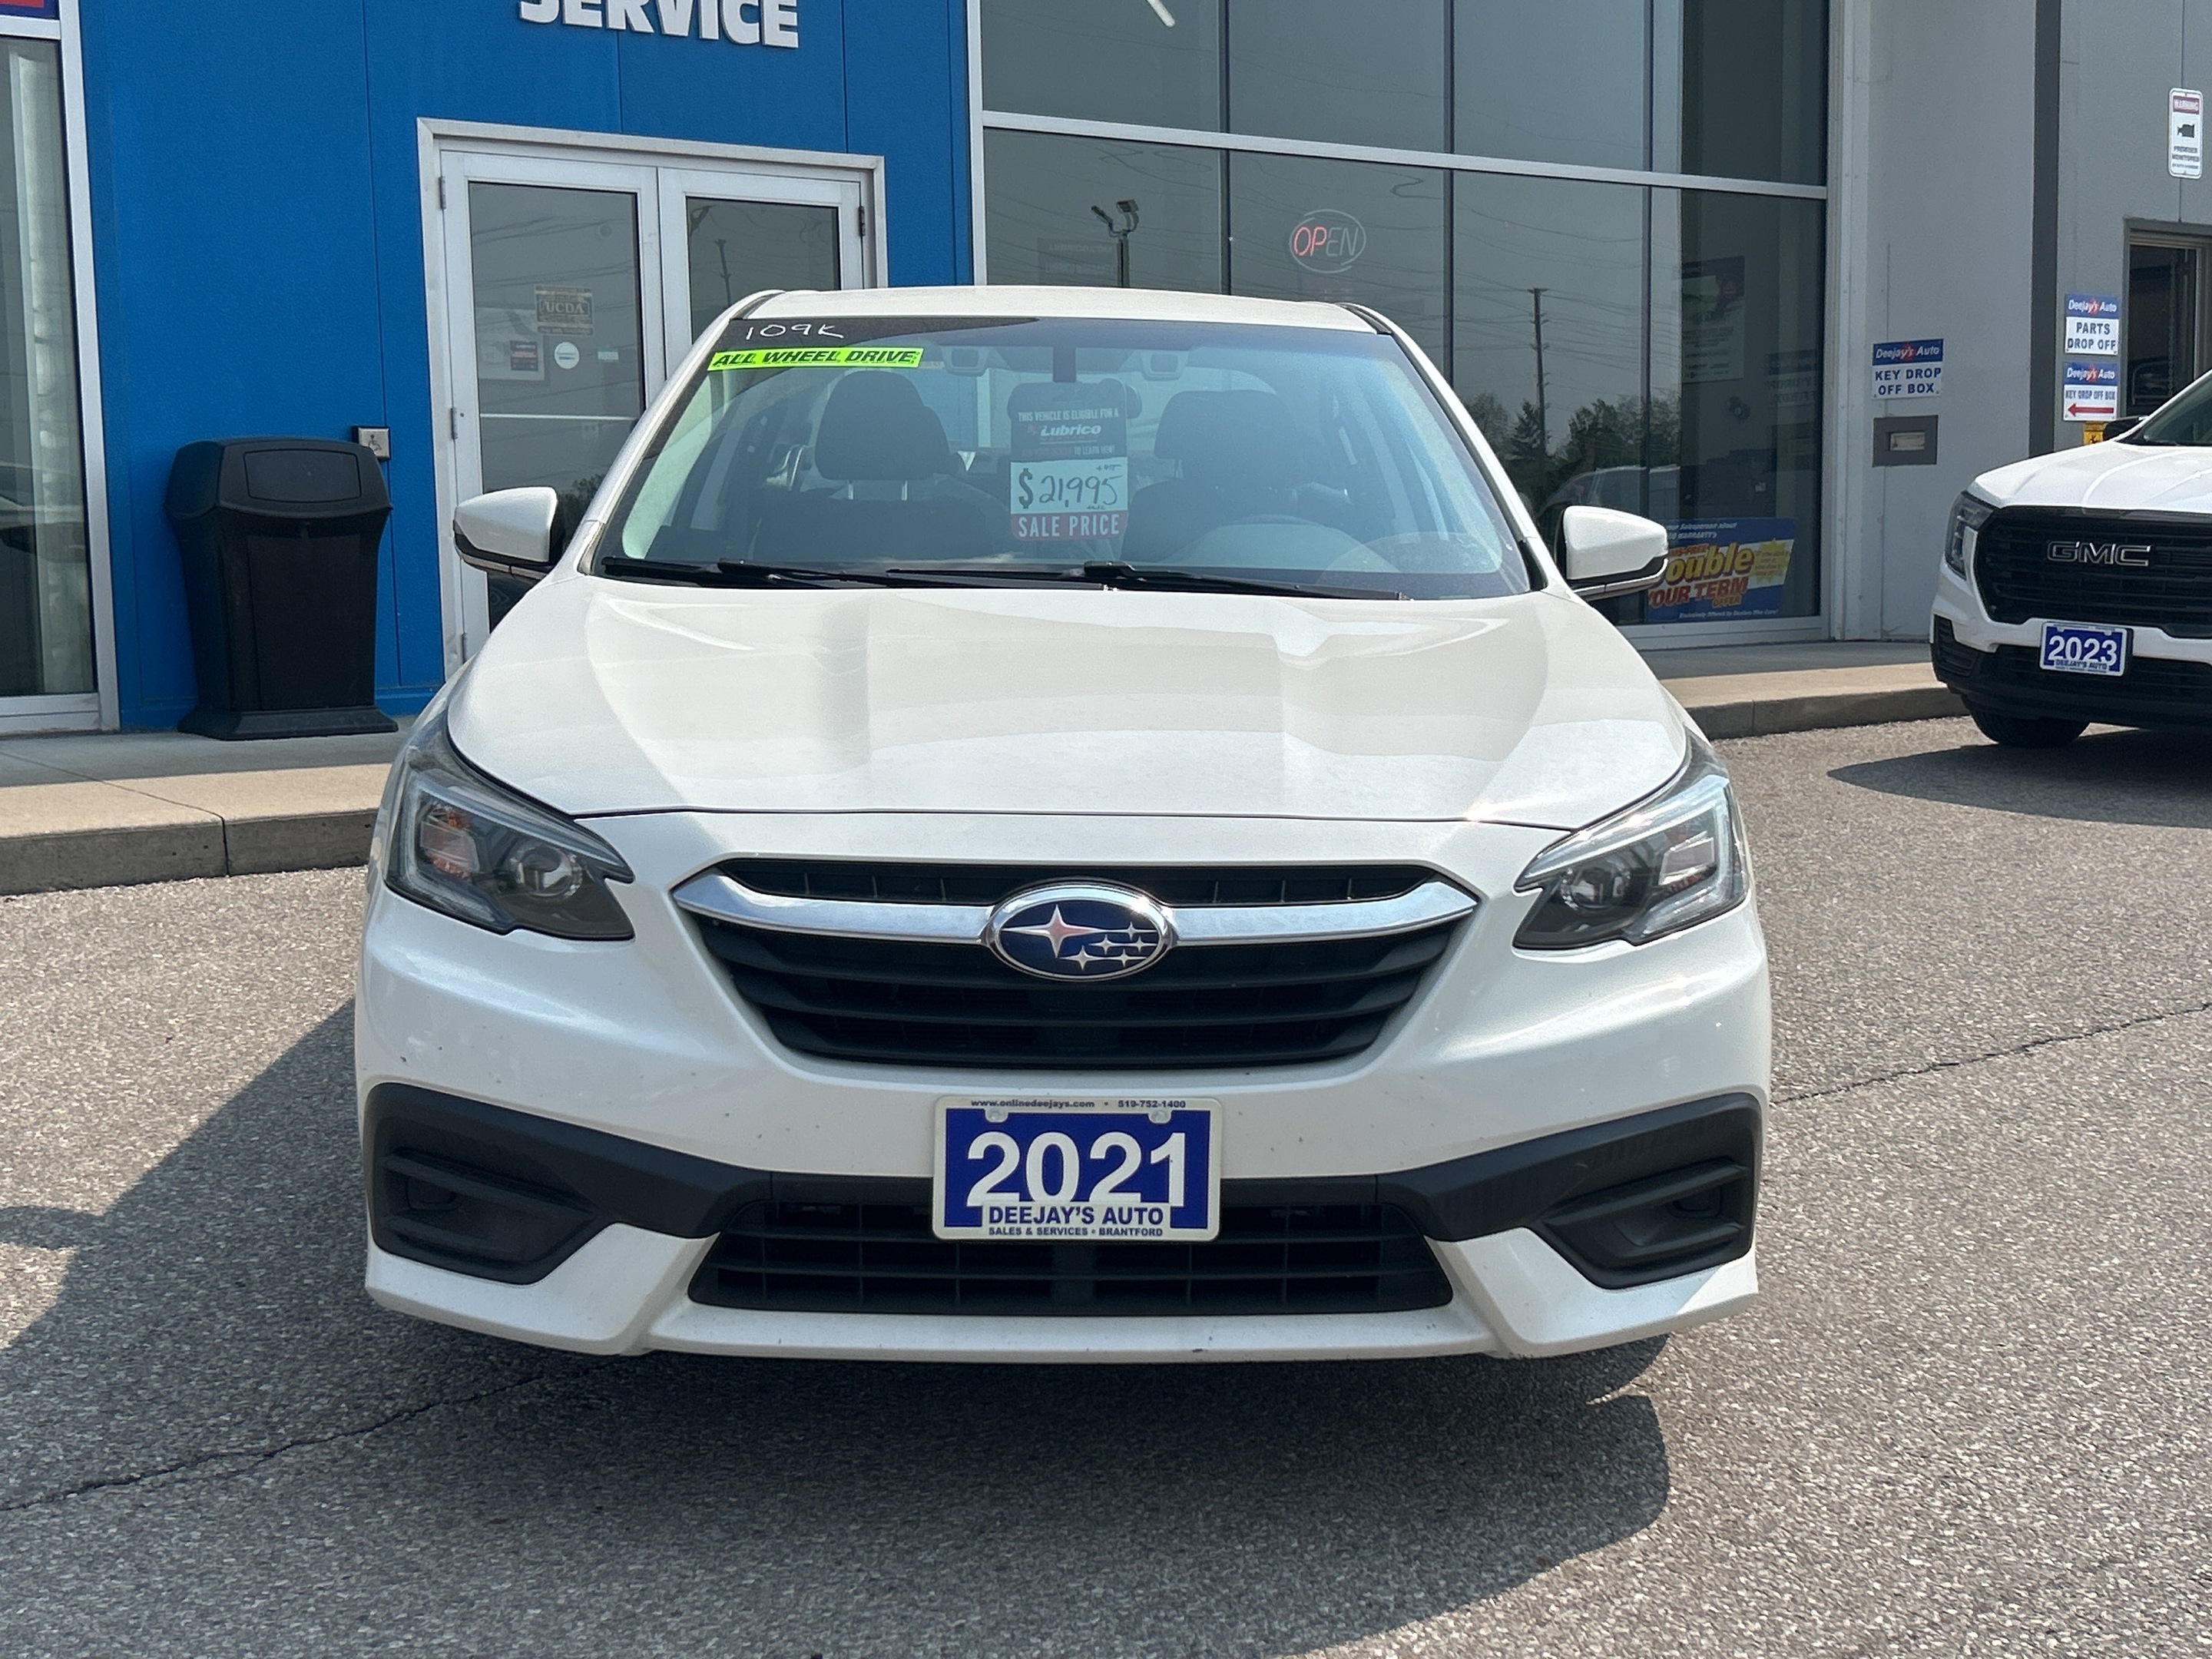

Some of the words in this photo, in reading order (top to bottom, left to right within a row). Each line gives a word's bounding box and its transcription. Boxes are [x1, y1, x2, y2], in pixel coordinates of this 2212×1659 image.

[1293, 227, 1359, 257] OPEN
[544, 302, 584, 314] UCDA
[2068, 299, 2098, 313] Deejay's
[2100, 301, 2118, 313] Auto
[746, 323, 843, 340] 109K
[2076, 322, 2111, 335] PARTS
[2067, 338, 2094, 349] DROP
[2098, 339, 2116, 350] OFF
[713, 353, 756, 366] ALL
[763, 350, 840, 364] WHEEL
[844, 350, 919, 363] DRIVE
[1876, 346, 1915, 360] Deejay's
[1916, 346, 1940, 356] Auto
[1875, 369, 1901, 381] KEY
[1906, 367, 1942, 379] DROP
[2066, 367, 2097, 381] Deejay's
[2098, 369, 2115, 379] Auto
[1878, 385, 1902, 396] OFF
[1908, 382, 1934, 394] BOX
[1018, 412, 1034, 422] THIS
[1035, 410, 1061, 422] VEHICLE
[1063, 409, 1069, 420] IS
[1071, 409, 1099, 420] ELIGIBLE
[1100, 409, 1113, 419] FOR
[1114, 408, 1119, 417] A
[1040, 424, 1102, 436] Lubrico
[1018, 516, 1061, 537] SALE
[1068, 514, 1120, 535] PRICE
[2047, 541, 2151, 567] GMC
[1664, 542, 1755, 587] ouble
[1694, 577, 1750, 601] TERM
[2048, 635, 2118, 666] 2023
[971, 1099, 1095, 1108] www.onlinedeejays.com
[1118, 1100, 1186, 1108] 519-752-1400
[965, 1131, 1186, 1207] 2021
[988, 1206, 1095, 1225] DEEJAY'S
[1102, 1207, 1164, 1225] AUTO
[988, 1227, 1022, 1236] SALES
[1025, 1227, 1032, 1236] &
[1036, 1227, 1088, 1236] SERVICES
[1098, 1227, 1164, 1237] BRANTFORD
